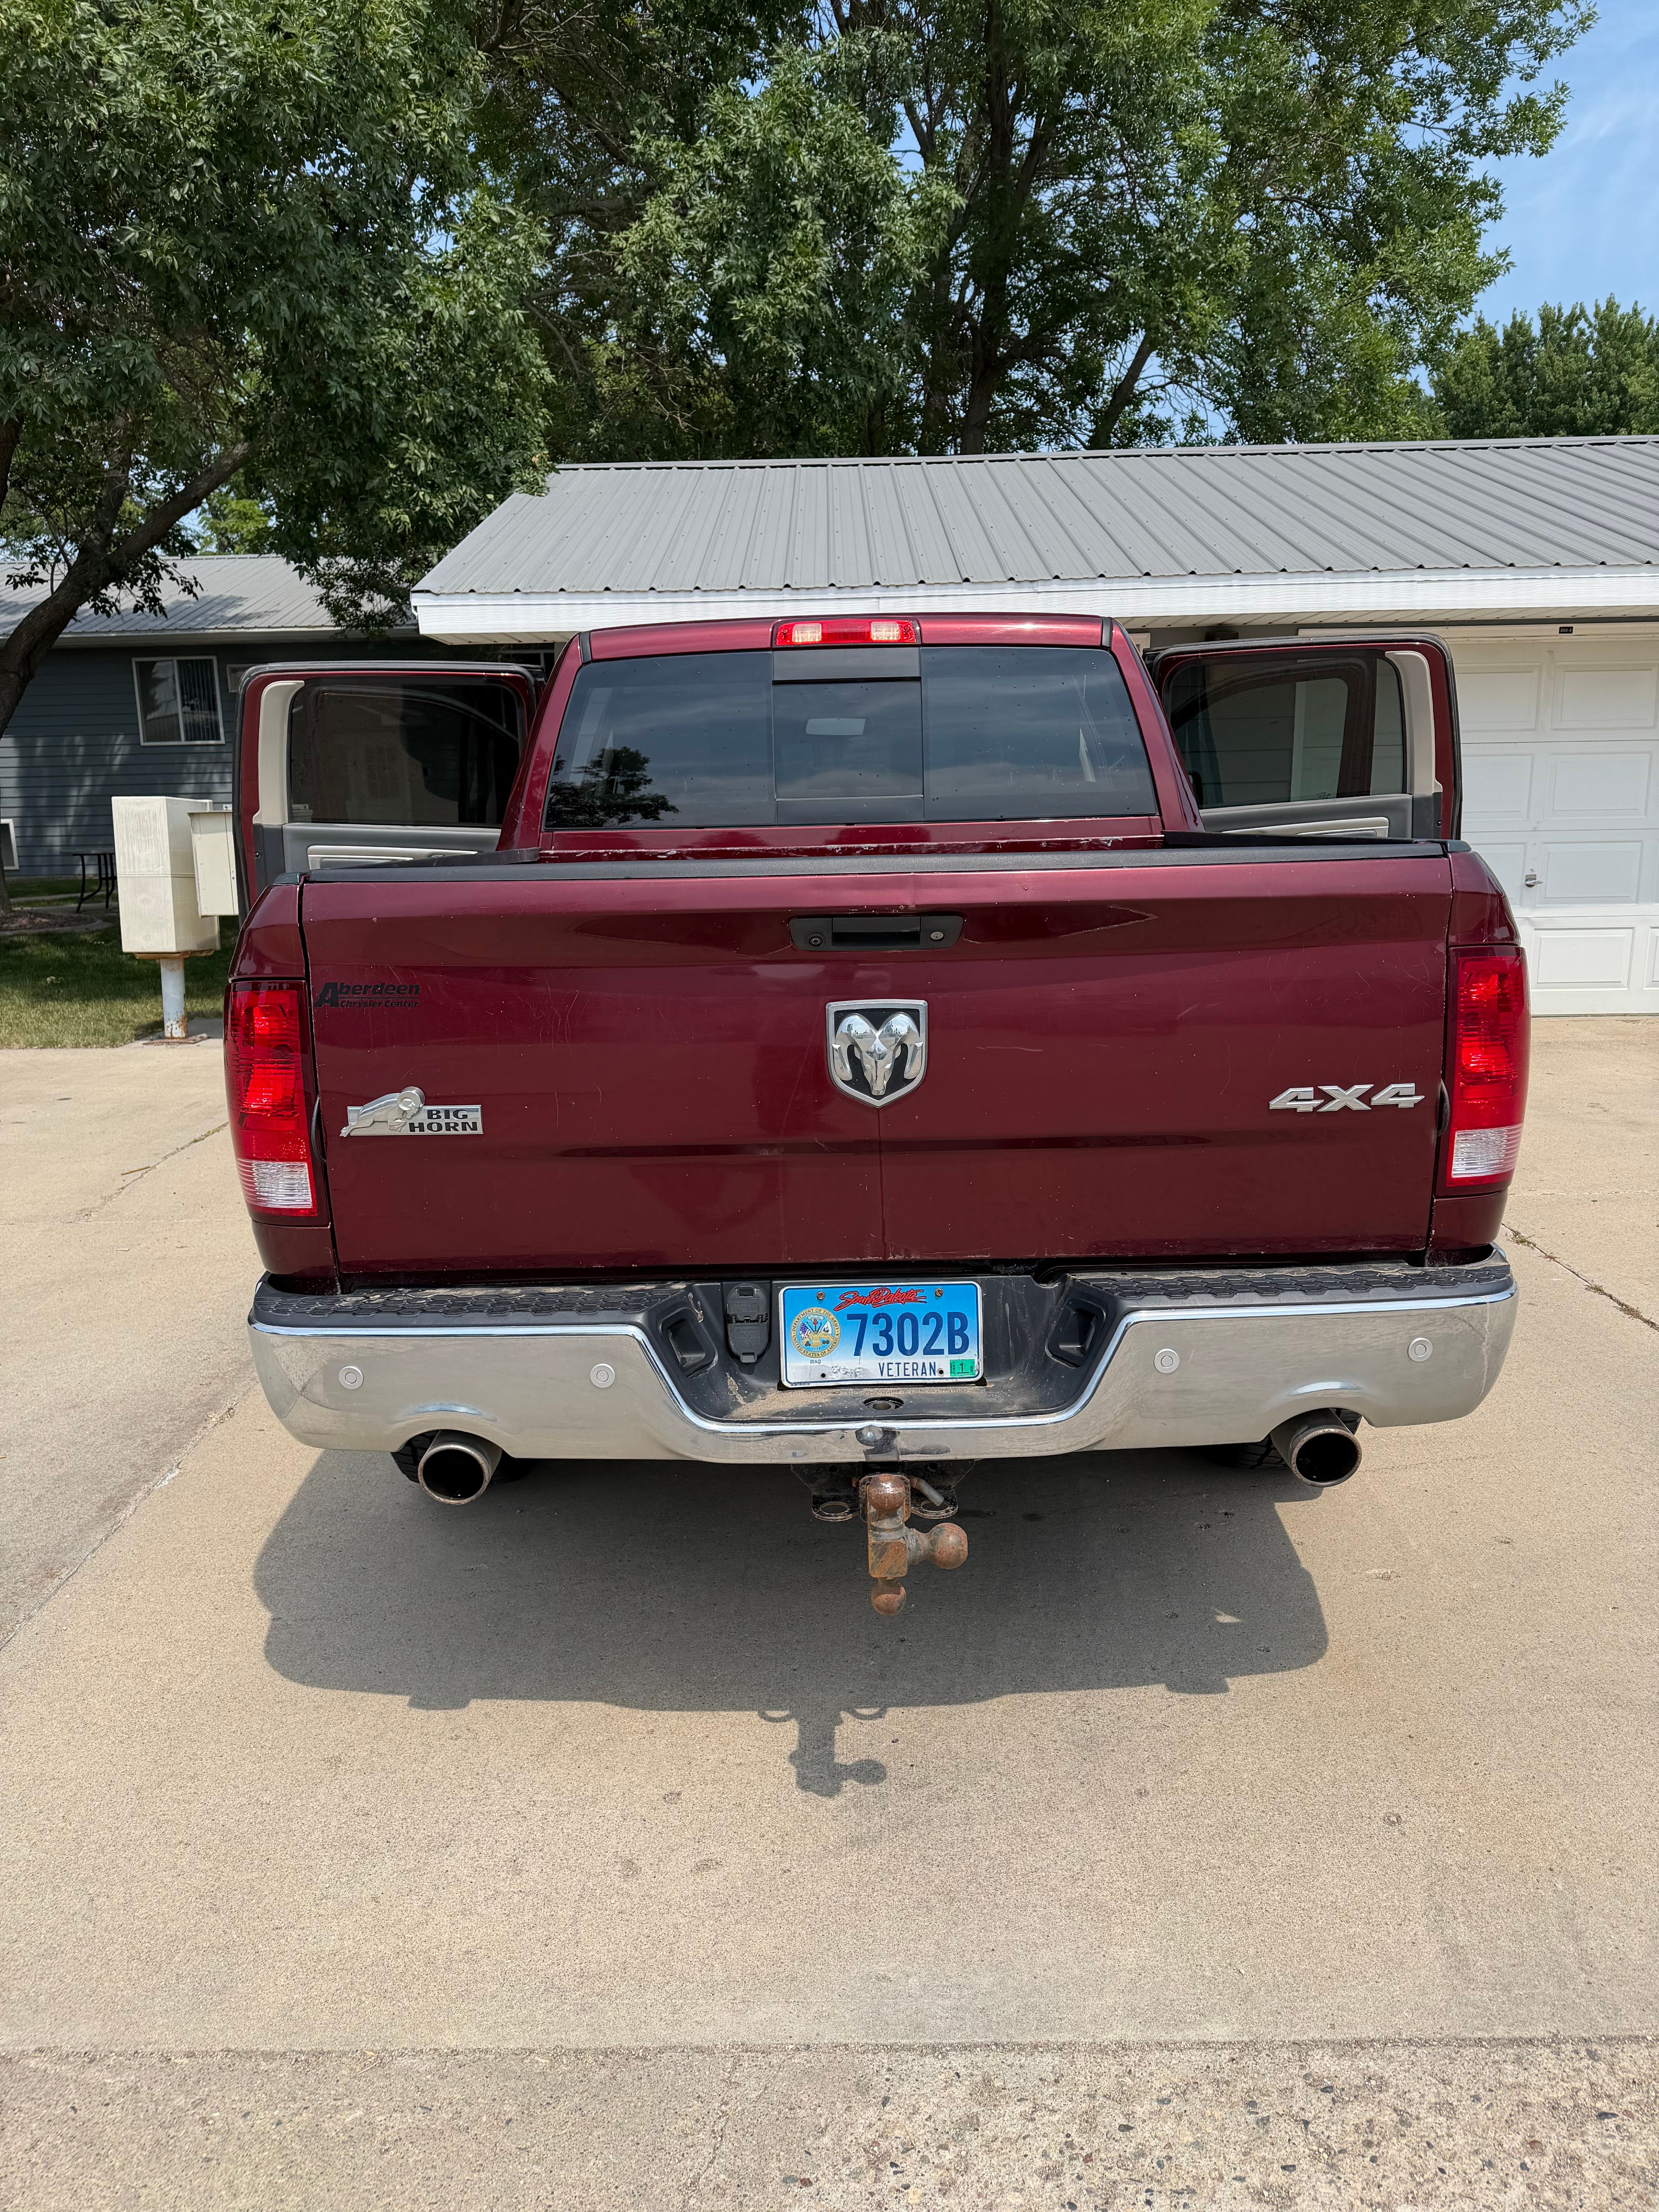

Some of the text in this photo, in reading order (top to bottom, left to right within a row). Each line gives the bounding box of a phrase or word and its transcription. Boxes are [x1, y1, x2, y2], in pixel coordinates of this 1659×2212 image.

[314, 982, 420, 1007] Aberdeen
[427, 1109, 468, 1120] BIG
[409, 1122, 477, 1133] HORN
[833, 1287, 927, 1312] South Dakota
[792, 1309, 814, 1332] DEPARTMENT
[831, 1317, 840, 1329] ARMY
[792, 1335, 803, 1351] UNITED
[827, 1333, 840, 1352] AMERICA
[847, 1312, 969, 1356] 7302B
[878, 1362, 936, 1377] VETERAN
